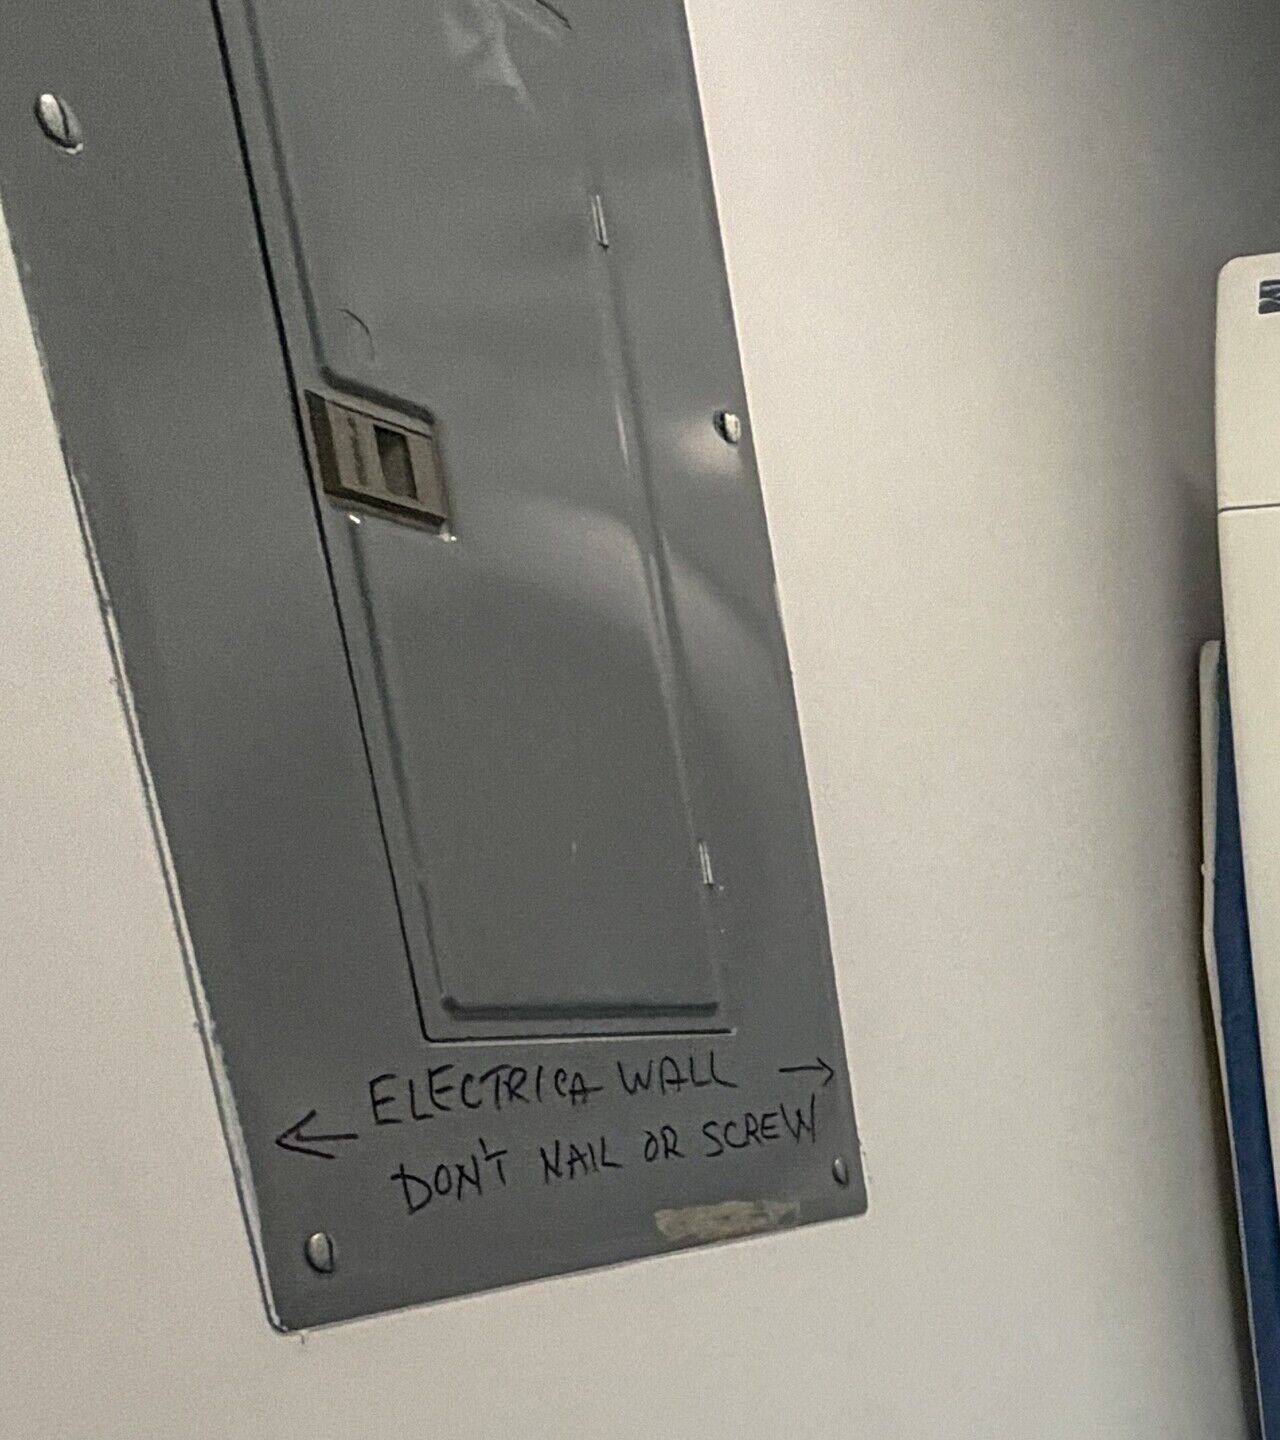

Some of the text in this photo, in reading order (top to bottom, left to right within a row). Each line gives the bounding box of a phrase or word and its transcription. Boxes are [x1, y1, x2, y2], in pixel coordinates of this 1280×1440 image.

[617, 1051, 738, 1096] WALL
[390, 1092, 816, 1215] DON'T NAIL OR SCREW
